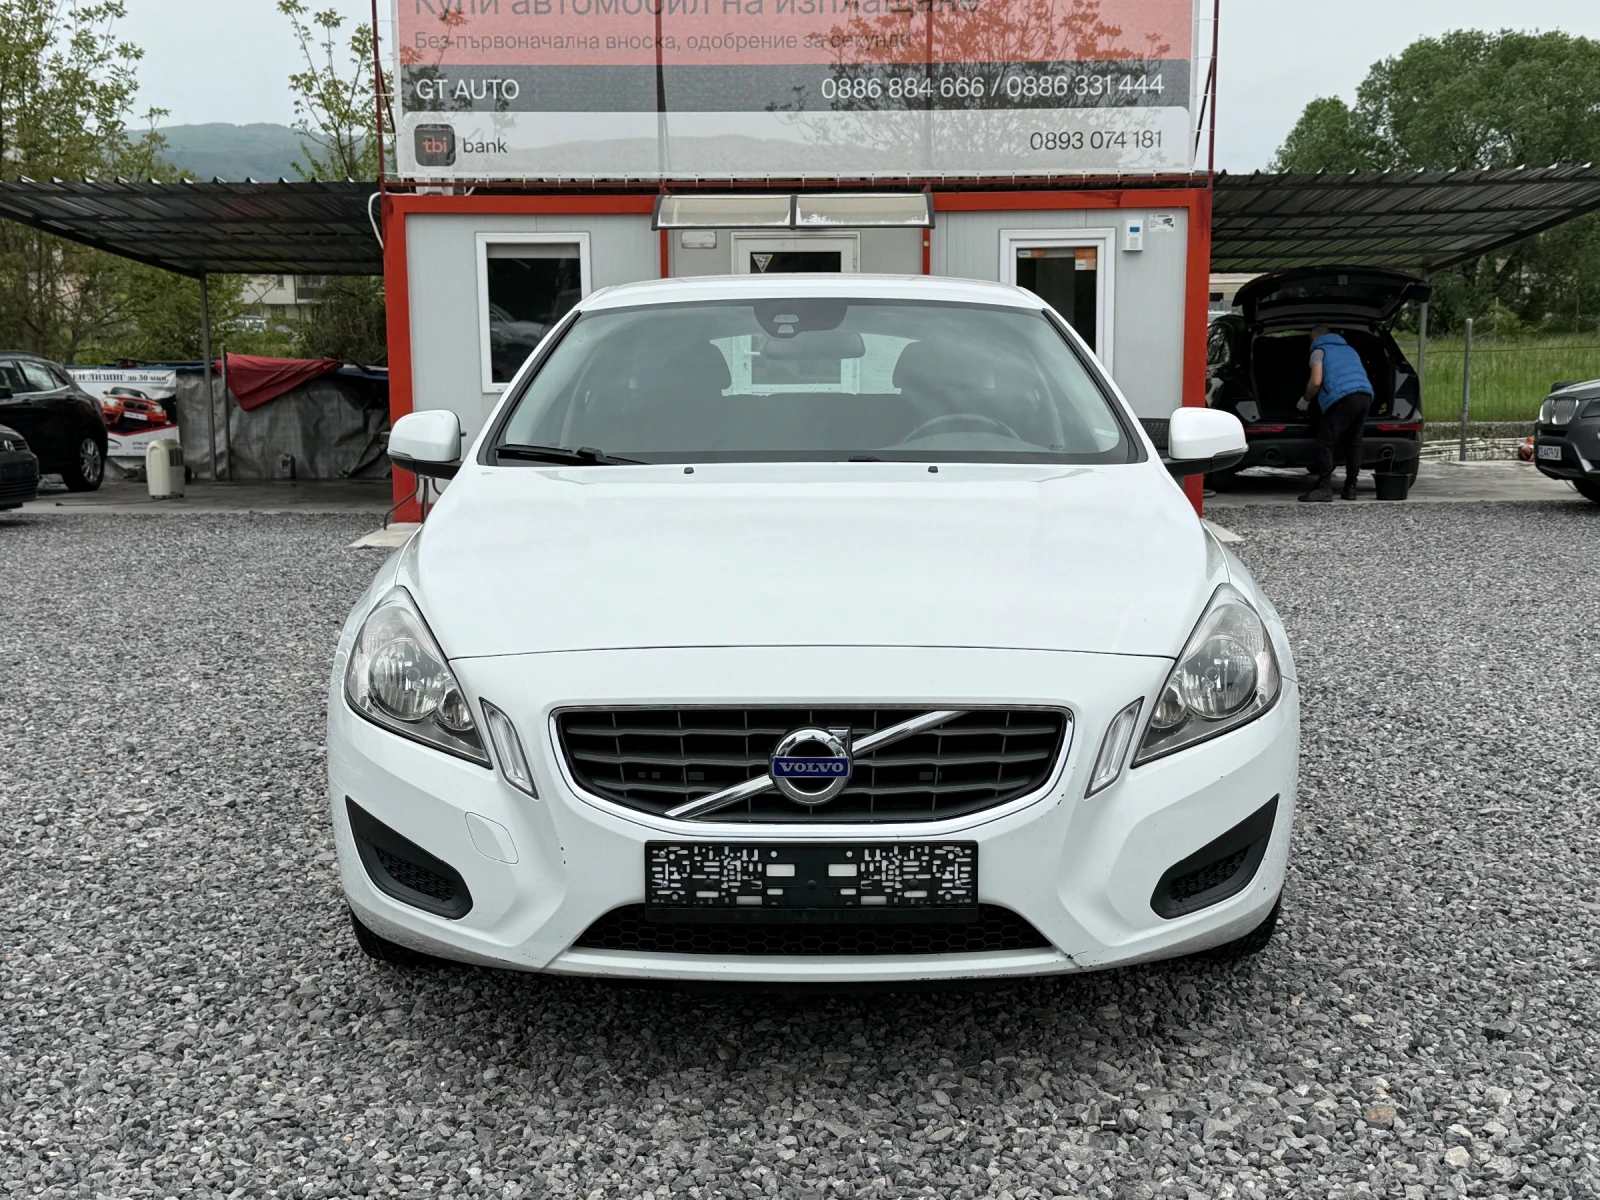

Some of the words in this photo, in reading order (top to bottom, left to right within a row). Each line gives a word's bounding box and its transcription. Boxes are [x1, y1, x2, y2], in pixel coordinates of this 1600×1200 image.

[723, 0, 763, 15] на
[415, 32, 450, 49] Без
[456, 35, 600, 52] първоначална
[606, 36, 681, 51] вноска,
[687, 32, 797, 52] одобрение
[803, 35, 824, 49] за
[830, 35, 911, 51] секунди
[416, 79, 448, 99] GT
[454, 79, 520, 99] AUTO
[821, 78, 881, 99] 0886
[889, 77, 934, 98] 884
[940, 76, 985, 98] 666
[990, 76, 1000, 98] /
[1007, 75, 1068, 97] 0886
[1074, 75, 1111, 96] 331
[1118, 74, 1165, 96] 444
[422, 137, 447, 154] tbi
[463, 137, 507, 154] bank
[1030, 131, 1084, 151] 0893
[1090, 130, 1127, 150] 074
[1133, 130, 1163, 149] 181
[779, 762, 844, 773] VOLVO
